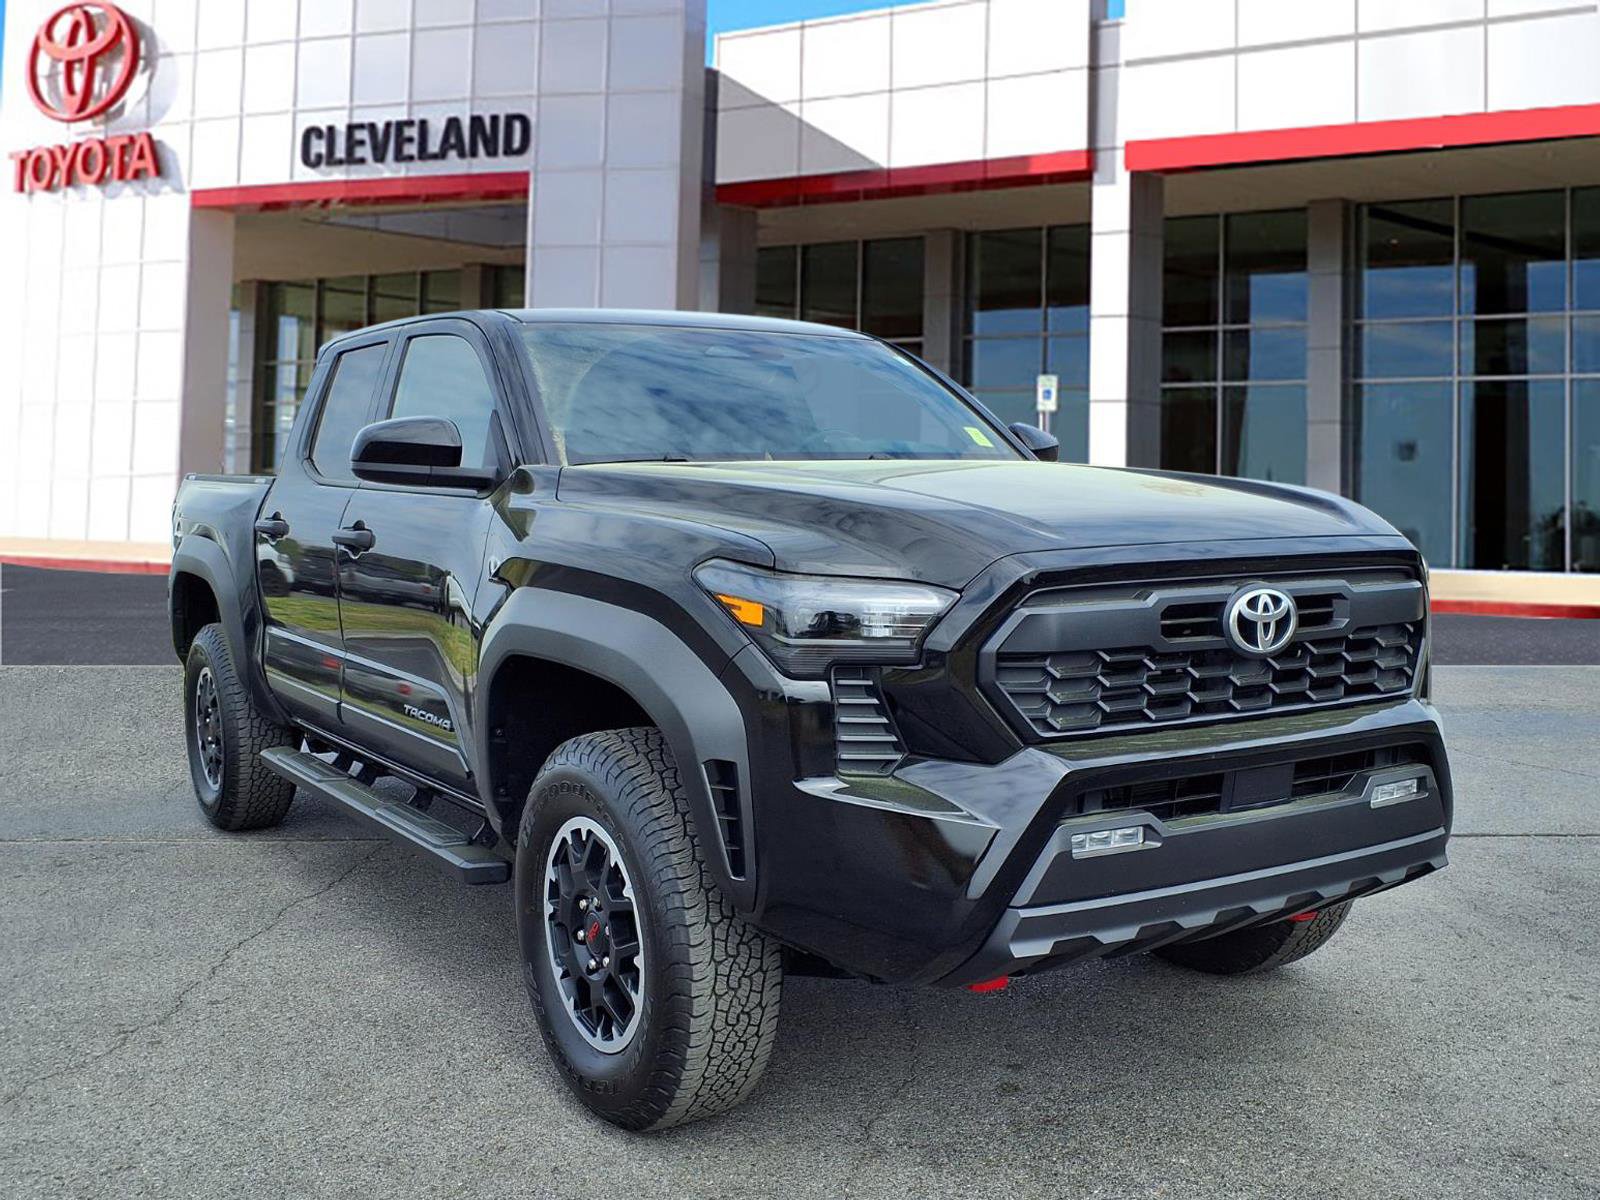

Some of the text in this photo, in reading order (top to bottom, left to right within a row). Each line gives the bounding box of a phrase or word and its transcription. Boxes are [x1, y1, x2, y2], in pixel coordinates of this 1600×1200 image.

[9, 132, 161, 193] TOYOTA
[301, 113, 531, 169] CLEVELAND
[403, 704, 451, 731] TACOMA
